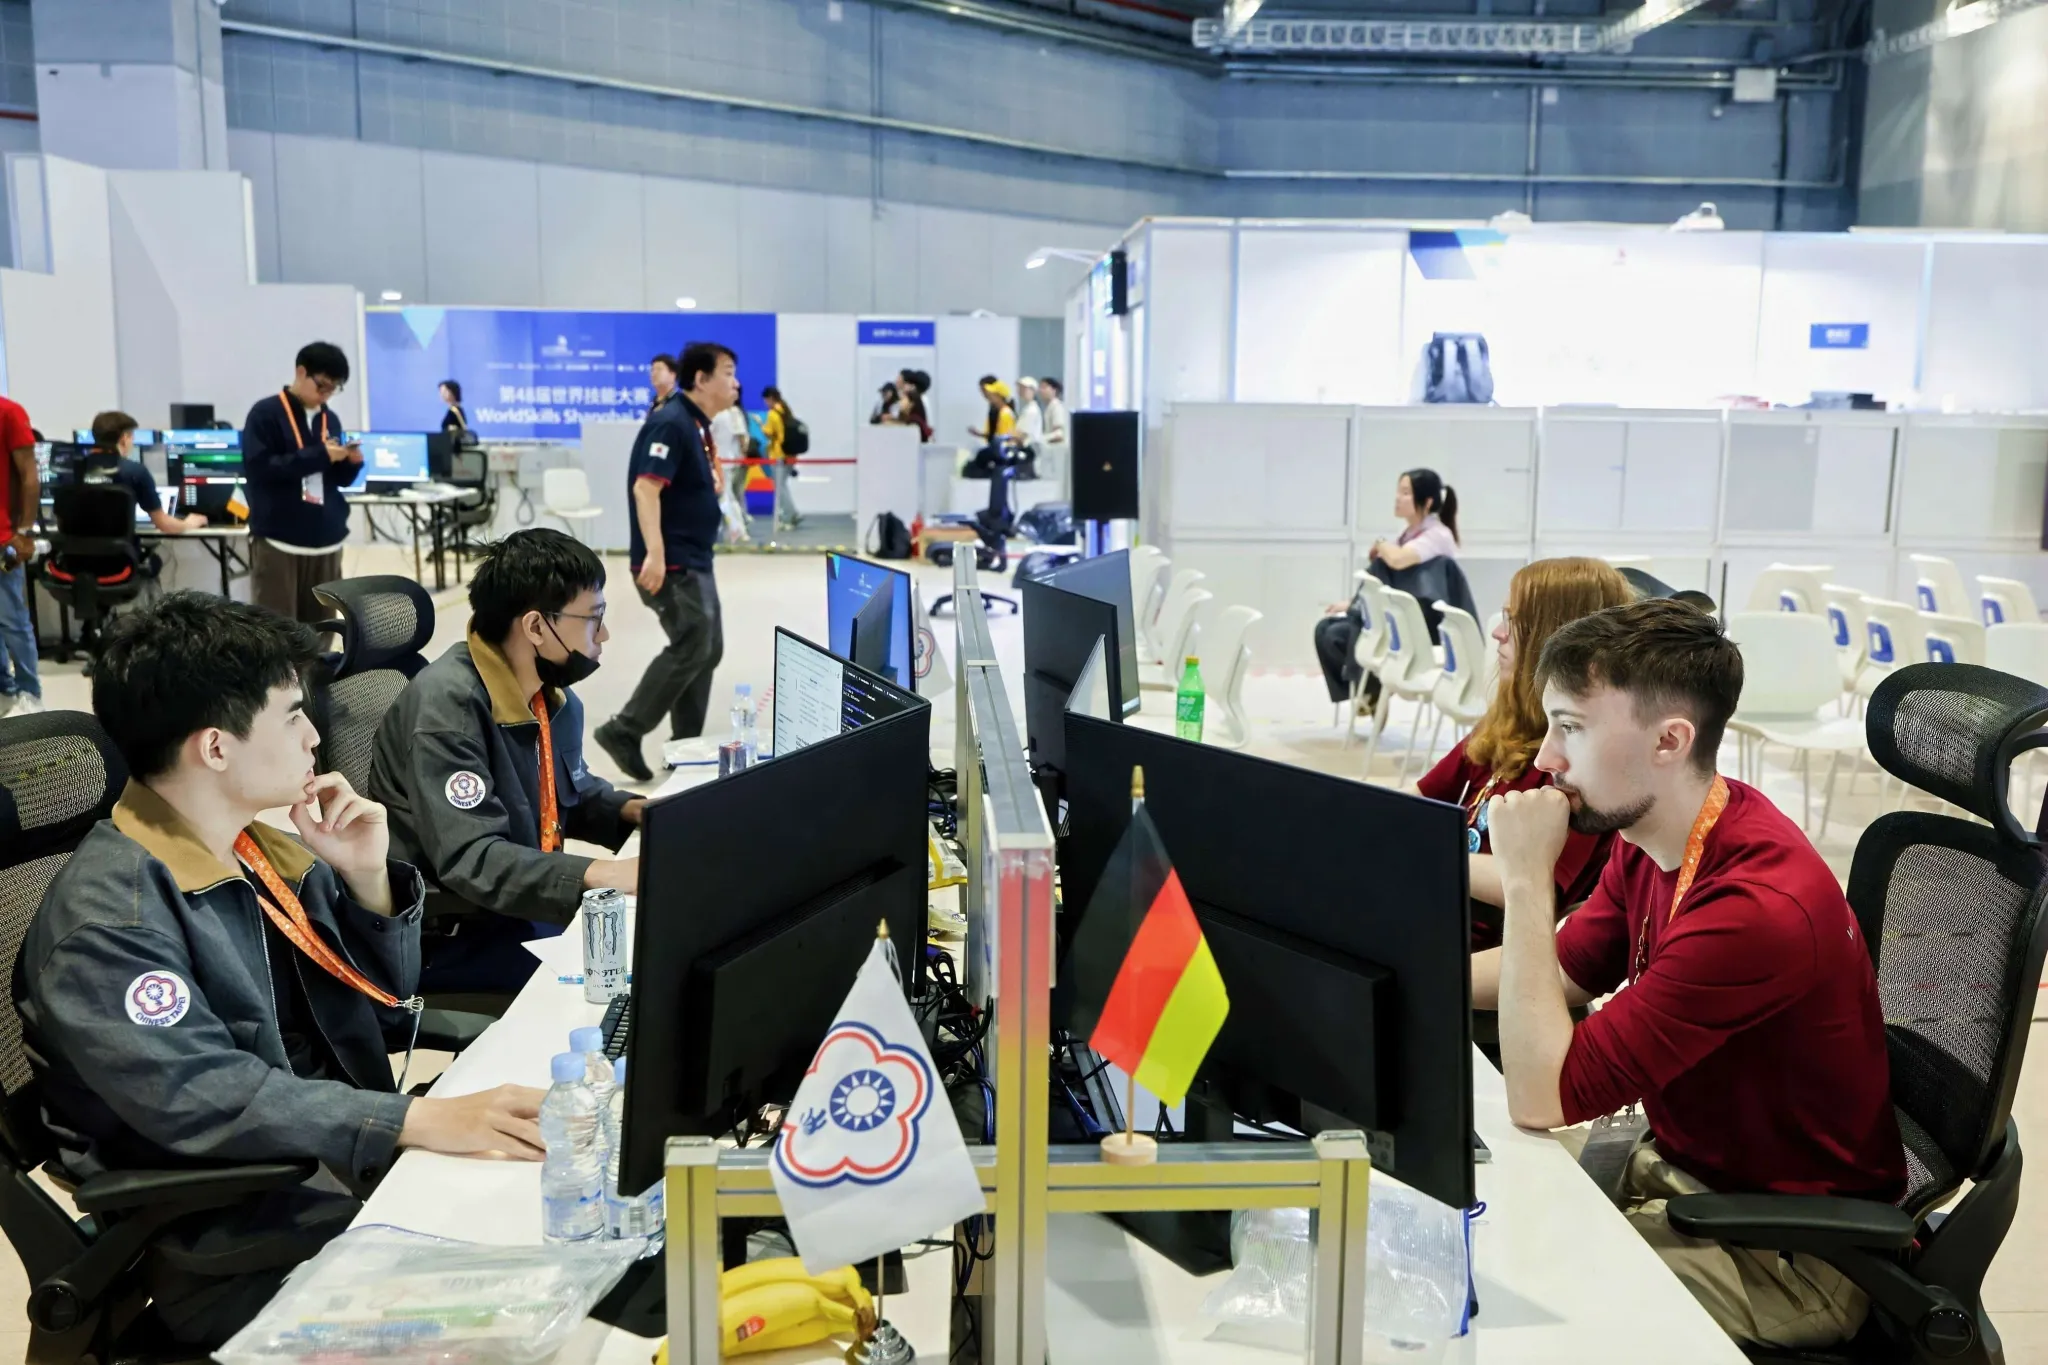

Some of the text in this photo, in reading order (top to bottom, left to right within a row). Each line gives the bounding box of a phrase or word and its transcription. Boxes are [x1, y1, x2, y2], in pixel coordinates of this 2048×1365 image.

[476, 408, 561, 424] WorldSkills
[136, 997, 186, 1026] CHINESE TAIPEI
